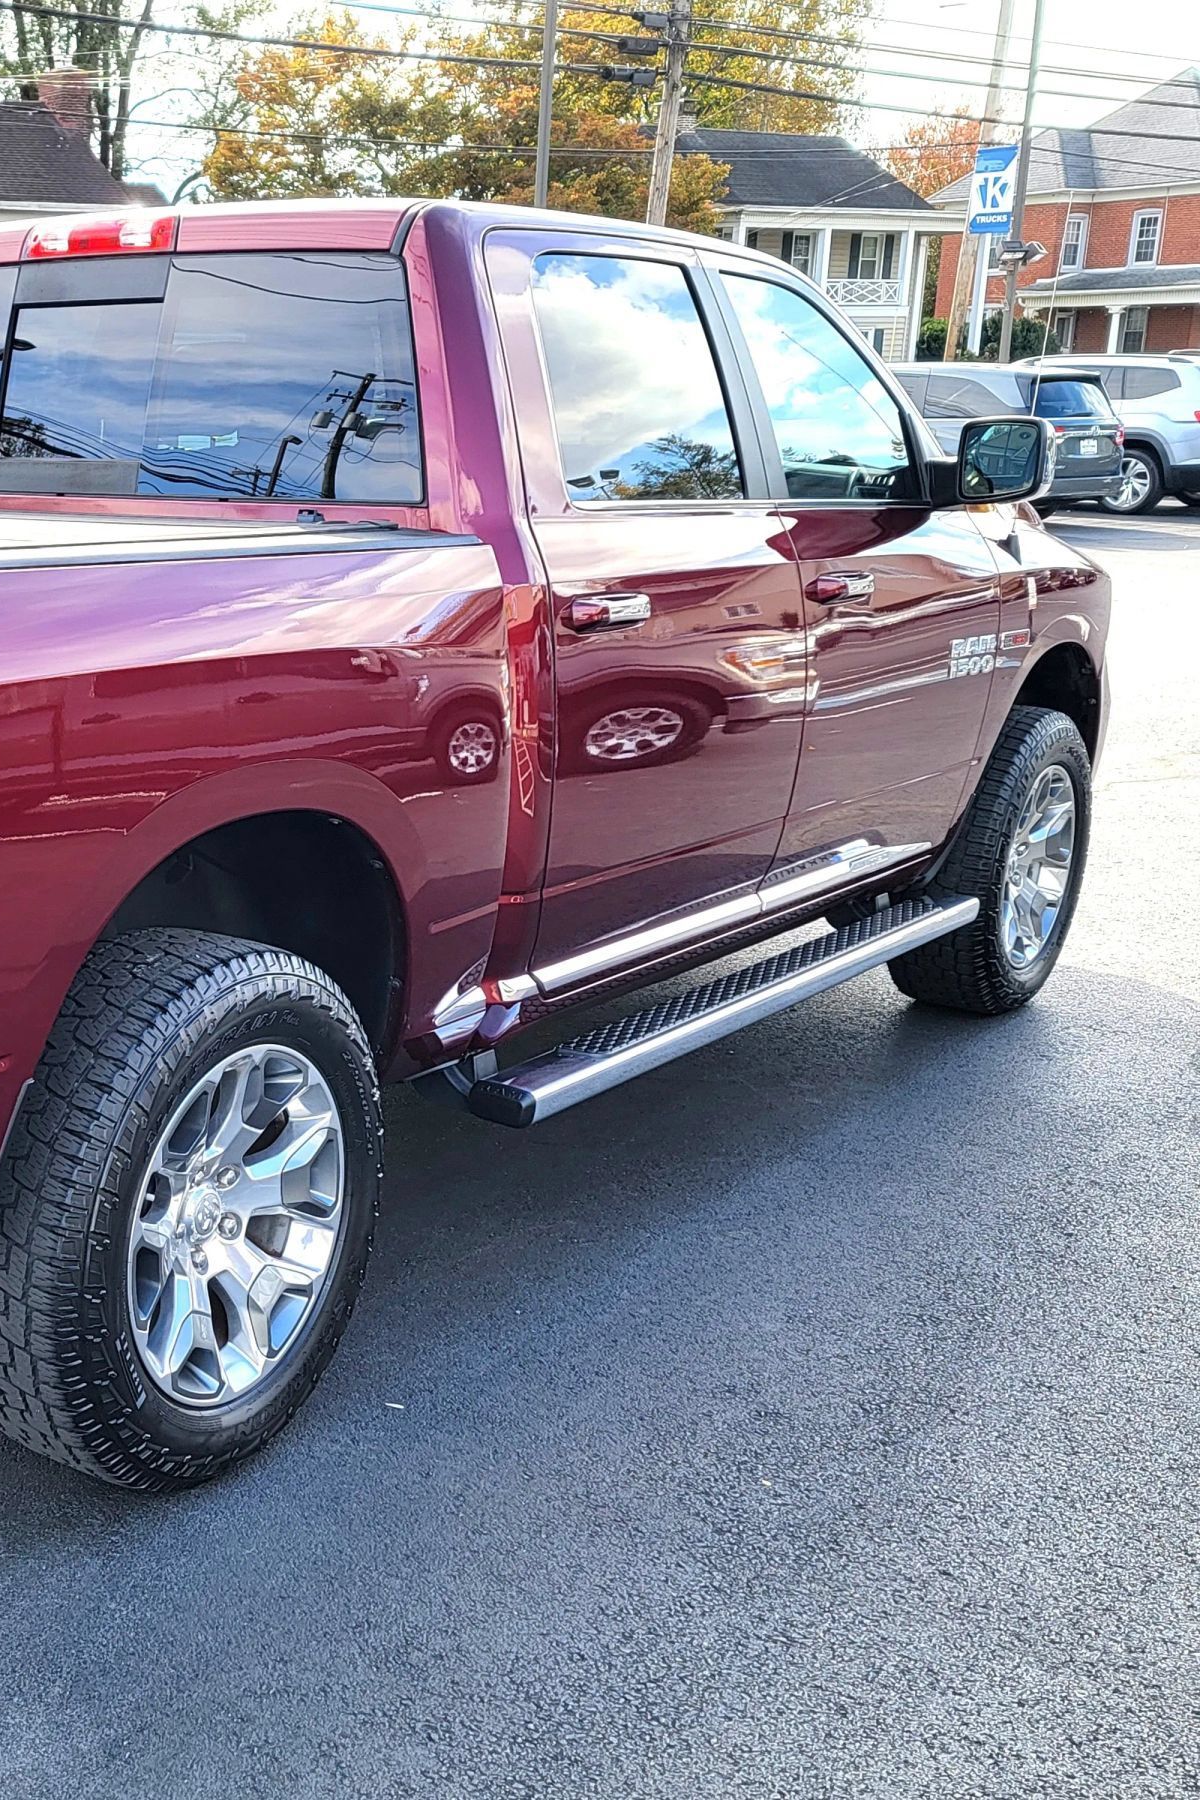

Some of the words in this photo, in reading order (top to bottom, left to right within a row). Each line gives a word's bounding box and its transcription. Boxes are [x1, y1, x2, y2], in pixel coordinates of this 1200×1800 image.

[975, 214, 1008, 224] TRUCKS
[949, 633, 997, 658] RAM
[949, 654, 995, 680] 1500
